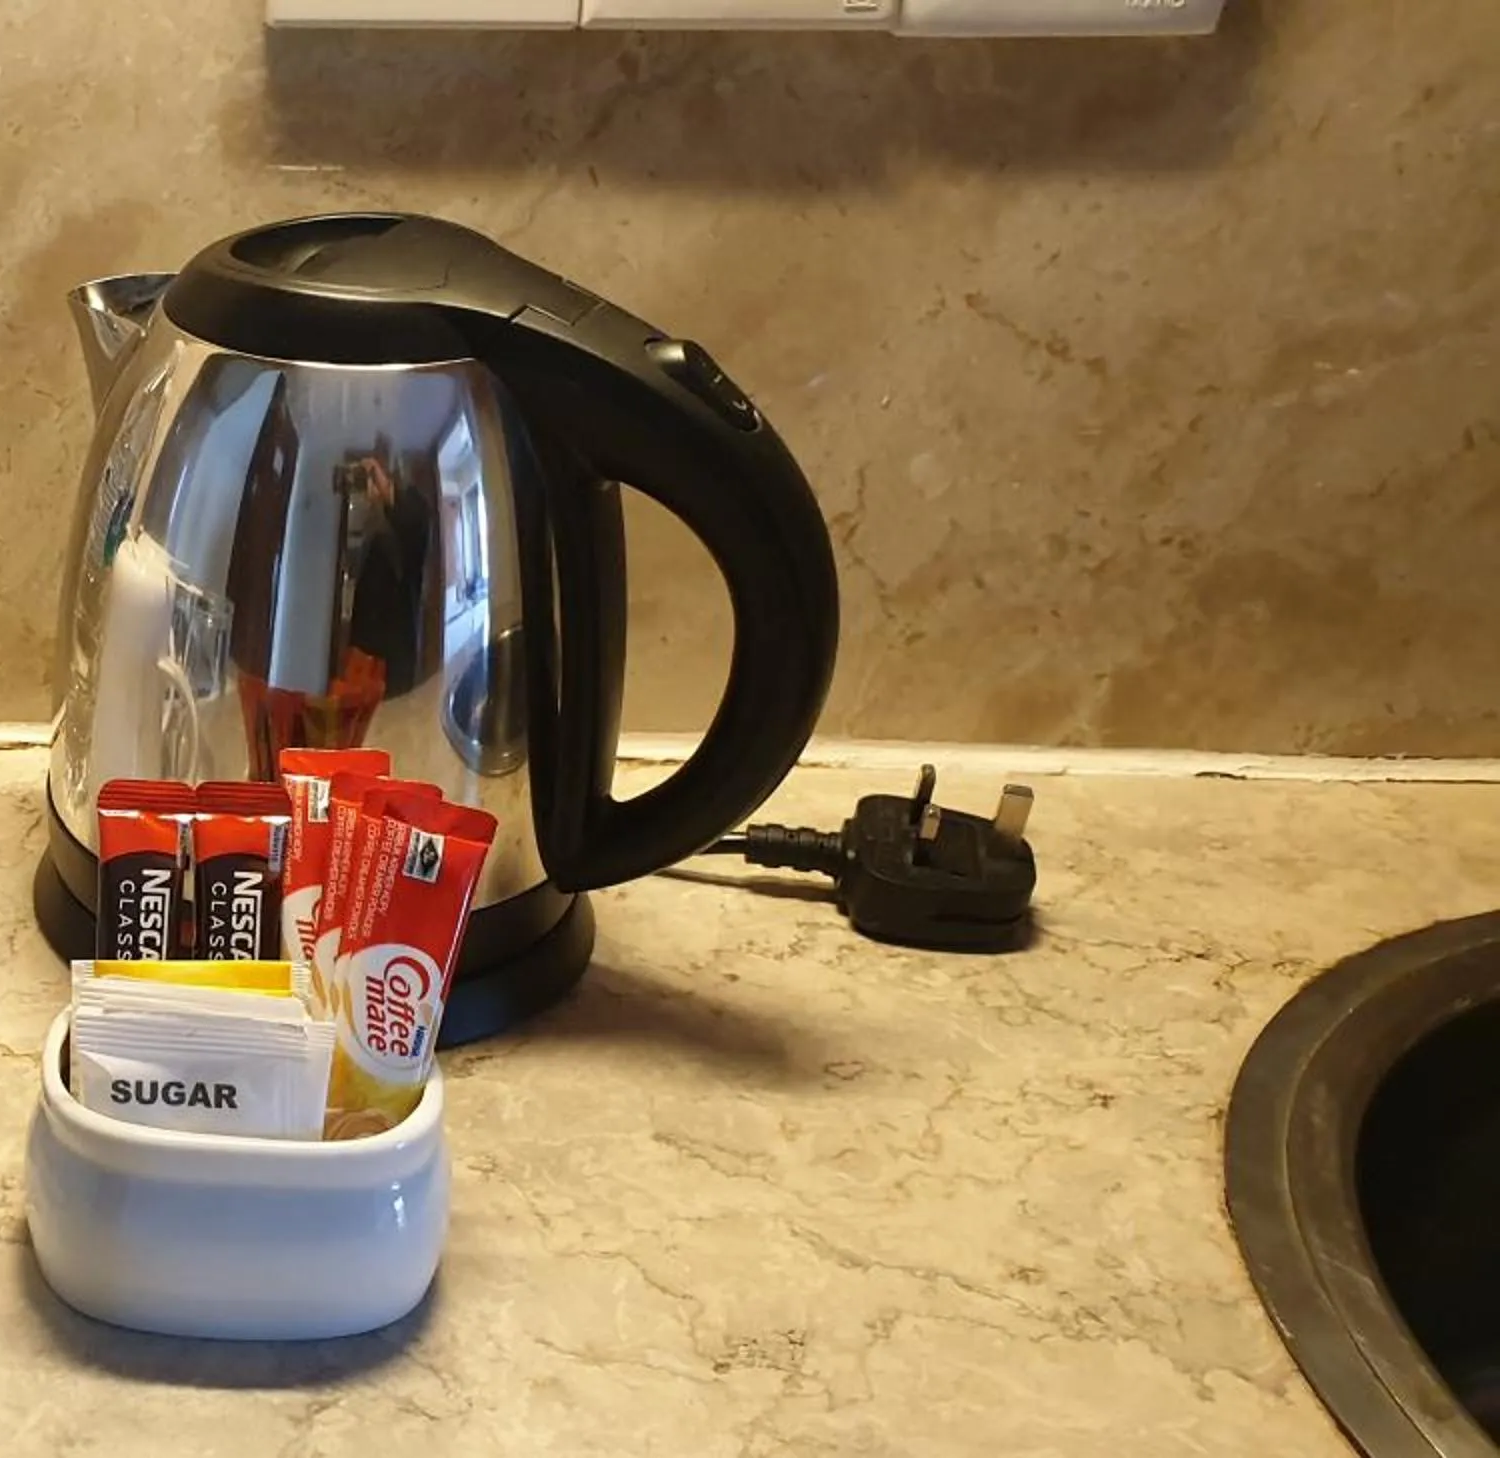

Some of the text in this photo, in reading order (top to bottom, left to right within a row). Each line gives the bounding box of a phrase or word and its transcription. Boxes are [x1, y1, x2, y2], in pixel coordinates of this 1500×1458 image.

[116, 879, 135, 960] CLASS
[139, 868, 171, 960] NESCA
[230, 871, 263, 960] NESCA
[366, 975, 388, 1053] mate
[383, 955, 431, 1057] Coffee
[110, 1079, 238, 1109] SUGAR
